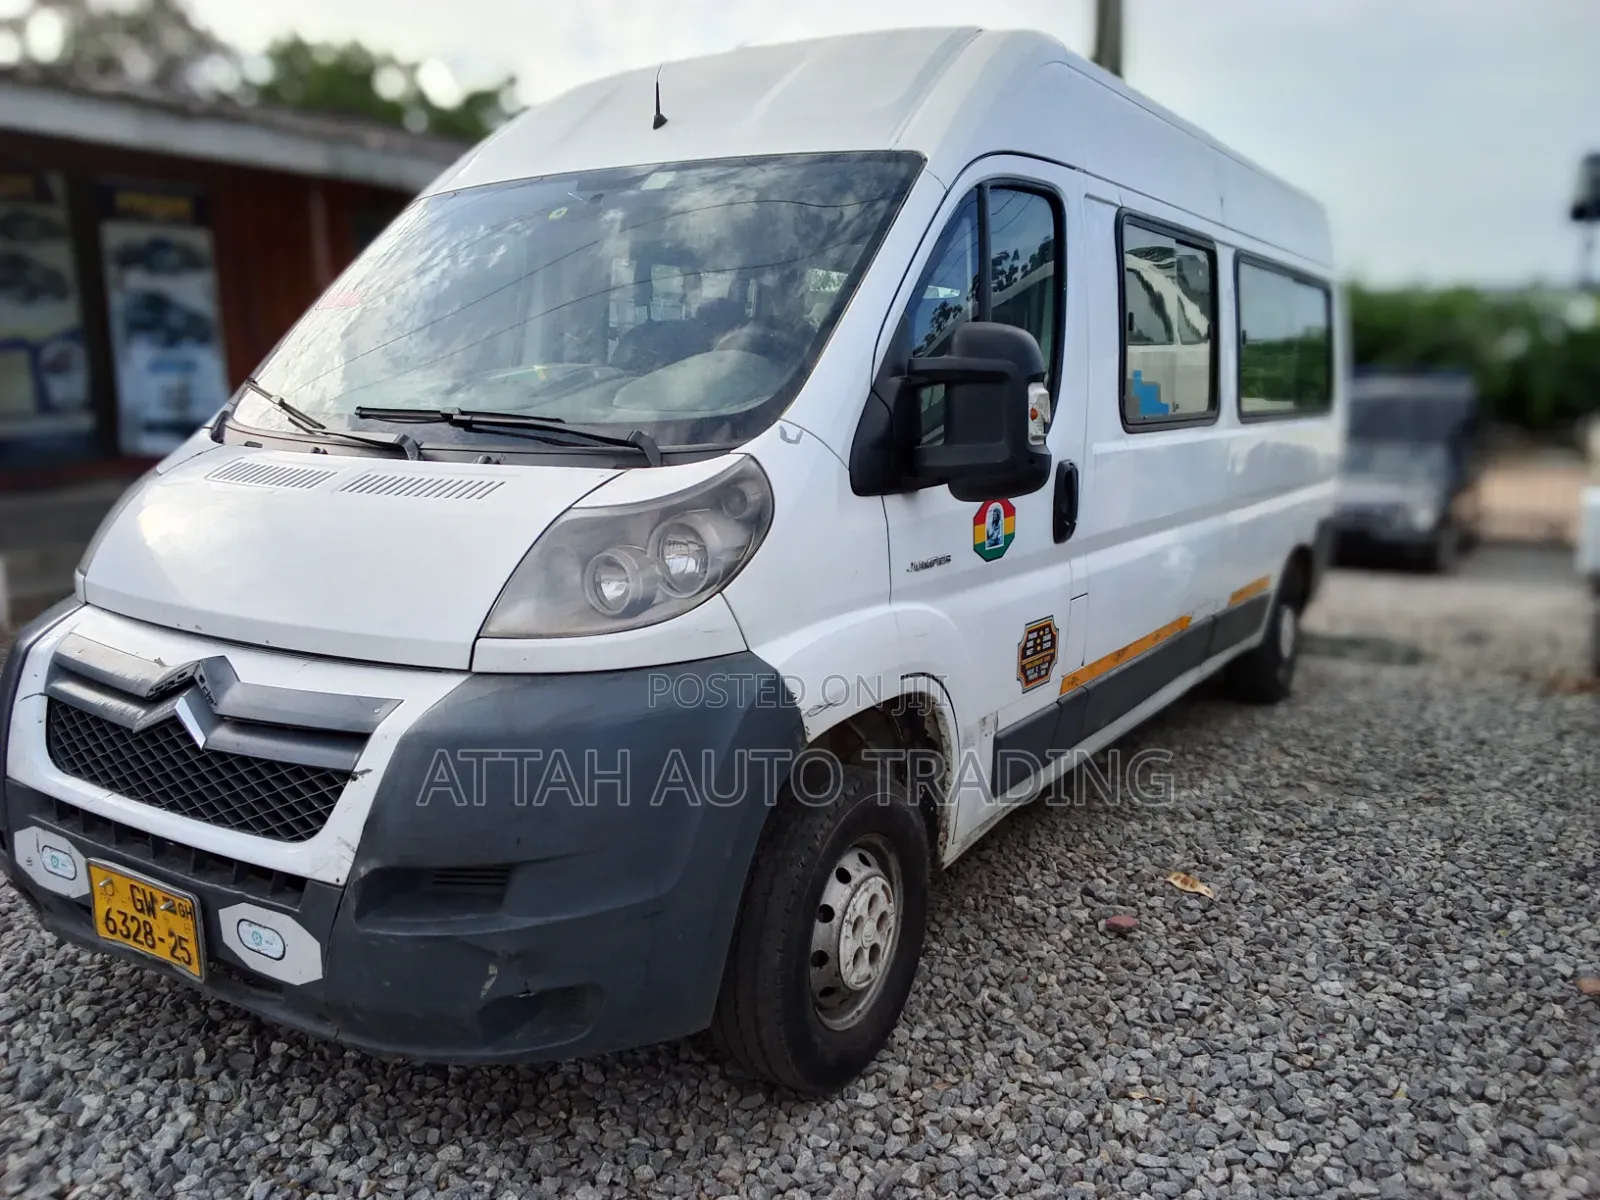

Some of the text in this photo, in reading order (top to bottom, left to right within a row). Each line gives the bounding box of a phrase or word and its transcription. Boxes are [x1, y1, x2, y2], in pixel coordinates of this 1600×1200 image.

[129, 883, 193, 921] GW GH
[104, 907, 193, 967] 6328-25
